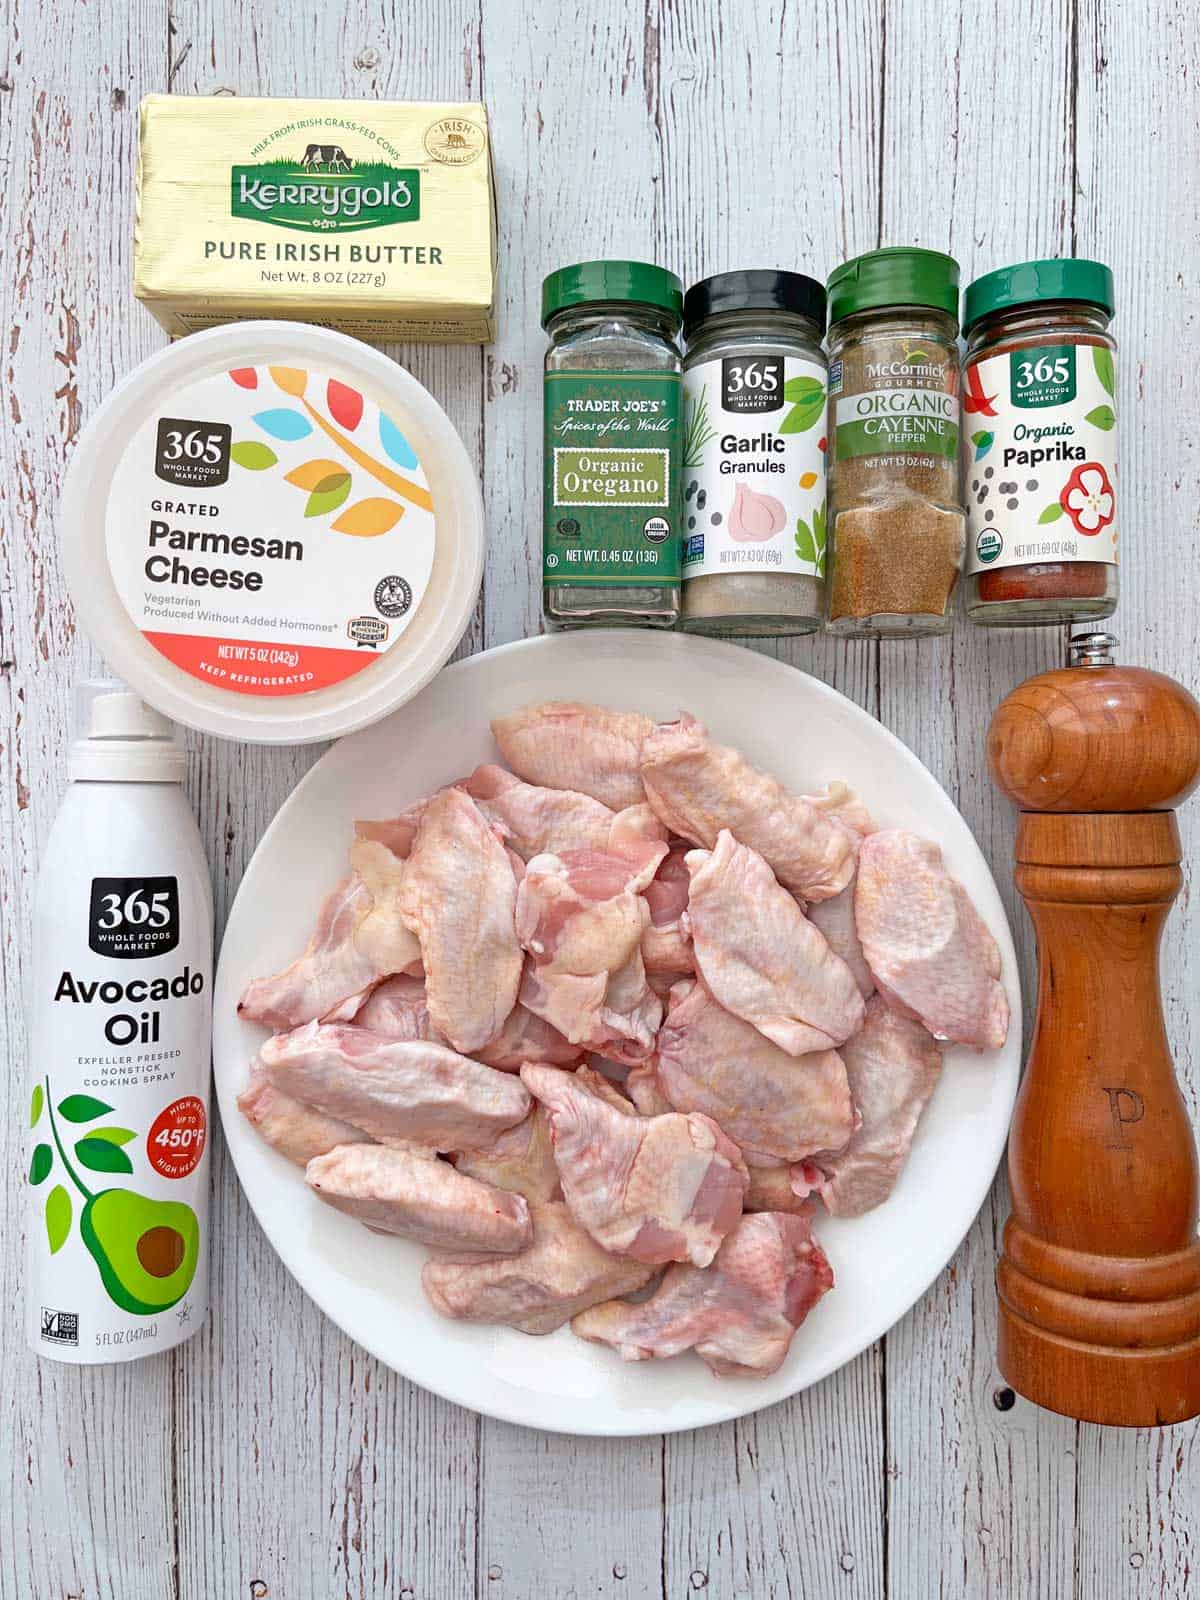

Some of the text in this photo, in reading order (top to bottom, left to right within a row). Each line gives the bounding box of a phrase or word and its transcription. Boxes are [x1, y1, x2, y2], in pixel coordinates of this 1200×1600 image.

[439, 121, 472, 134] IRISH
[250, 118, 401, 161] MILK FROM IRISH GRASS-FED COWS
[204, 241, 443, 265] PURE IRISH BUTTER
[261, 271, 386, 288] Net Wt. 8 OZ (227g)
[728, 362, 778, 393] 365
[865, 361, 944, 377] McCormick
[1016, 356, 1069, 388] 365
[875, 379, 940, 388] GOURMET
[1017, 389, 1042, 398] WHOLE
[567, 400, 660, 412] TRADER JOE'S
[857, 393, 953, 416] ORGANIC
[554, 416, 595, 438] Spices
[637, 418, 674, 432] World
[864, 417, 945, 435] CAYENNE
[1014, 422, 1075, 443] Organic
[721, 433, 785, 454] Garlic
[888, 433, 926, 443] PEPPER
[163, 430, 223, 464] 365
[1003, 441, 1086, 468] Paprika
[163, 464, 221, 475] WHOLE FOODS
[579, 456, 644, 475] Organic
[719, 458, 786, 474] Granules
[175, 473, 208, 481] MARKET
[563, 472, 659, 496] Oregano
[151, 500, 219, 517] GRATED
[149, 520, 304, 561] Parmesan
[566, 550, 582, 562] NET
[601, 550, 620, 562] 0.45
[622, 550, 633, 562] OZ
[636, 550, 658, 565] (13G)
[145, 555, 263, 592] Cheese
[144, 592, 201, 607] Vegetarian
[143, 606, 194, 620] Produced
[197, 610, 239, 624] Without
[242, 616, 277, 627] Added
[218, 645, 299, 667] NET WT 5 OZ (142g)
[199, 661, 315, 686] KEEP REFRIGERATED
[98, 889, 171, 929] 365
[98, 932, 171, 942] WHOLE FOODS
[114, 942, 156, 951] MARKET
[54, 966, 204, 1004] Avocado
[104, 1011, 160, 1046] Oil
[78, 1049, 181, 1065] EXPELLER PRESSED
[101, 1063, 161, 1076] NONSTICK
[83, 1071, 176, 1087] COOKING SPRAY
[169, 1101, 192, 1116] HIGH
[156, 1158, 177, 1173] HIGH
[96, 1334, 101, 1345] 5
[103, 1333, 113, 1345] FL
[113, 1331, 125, 1344] OZ
